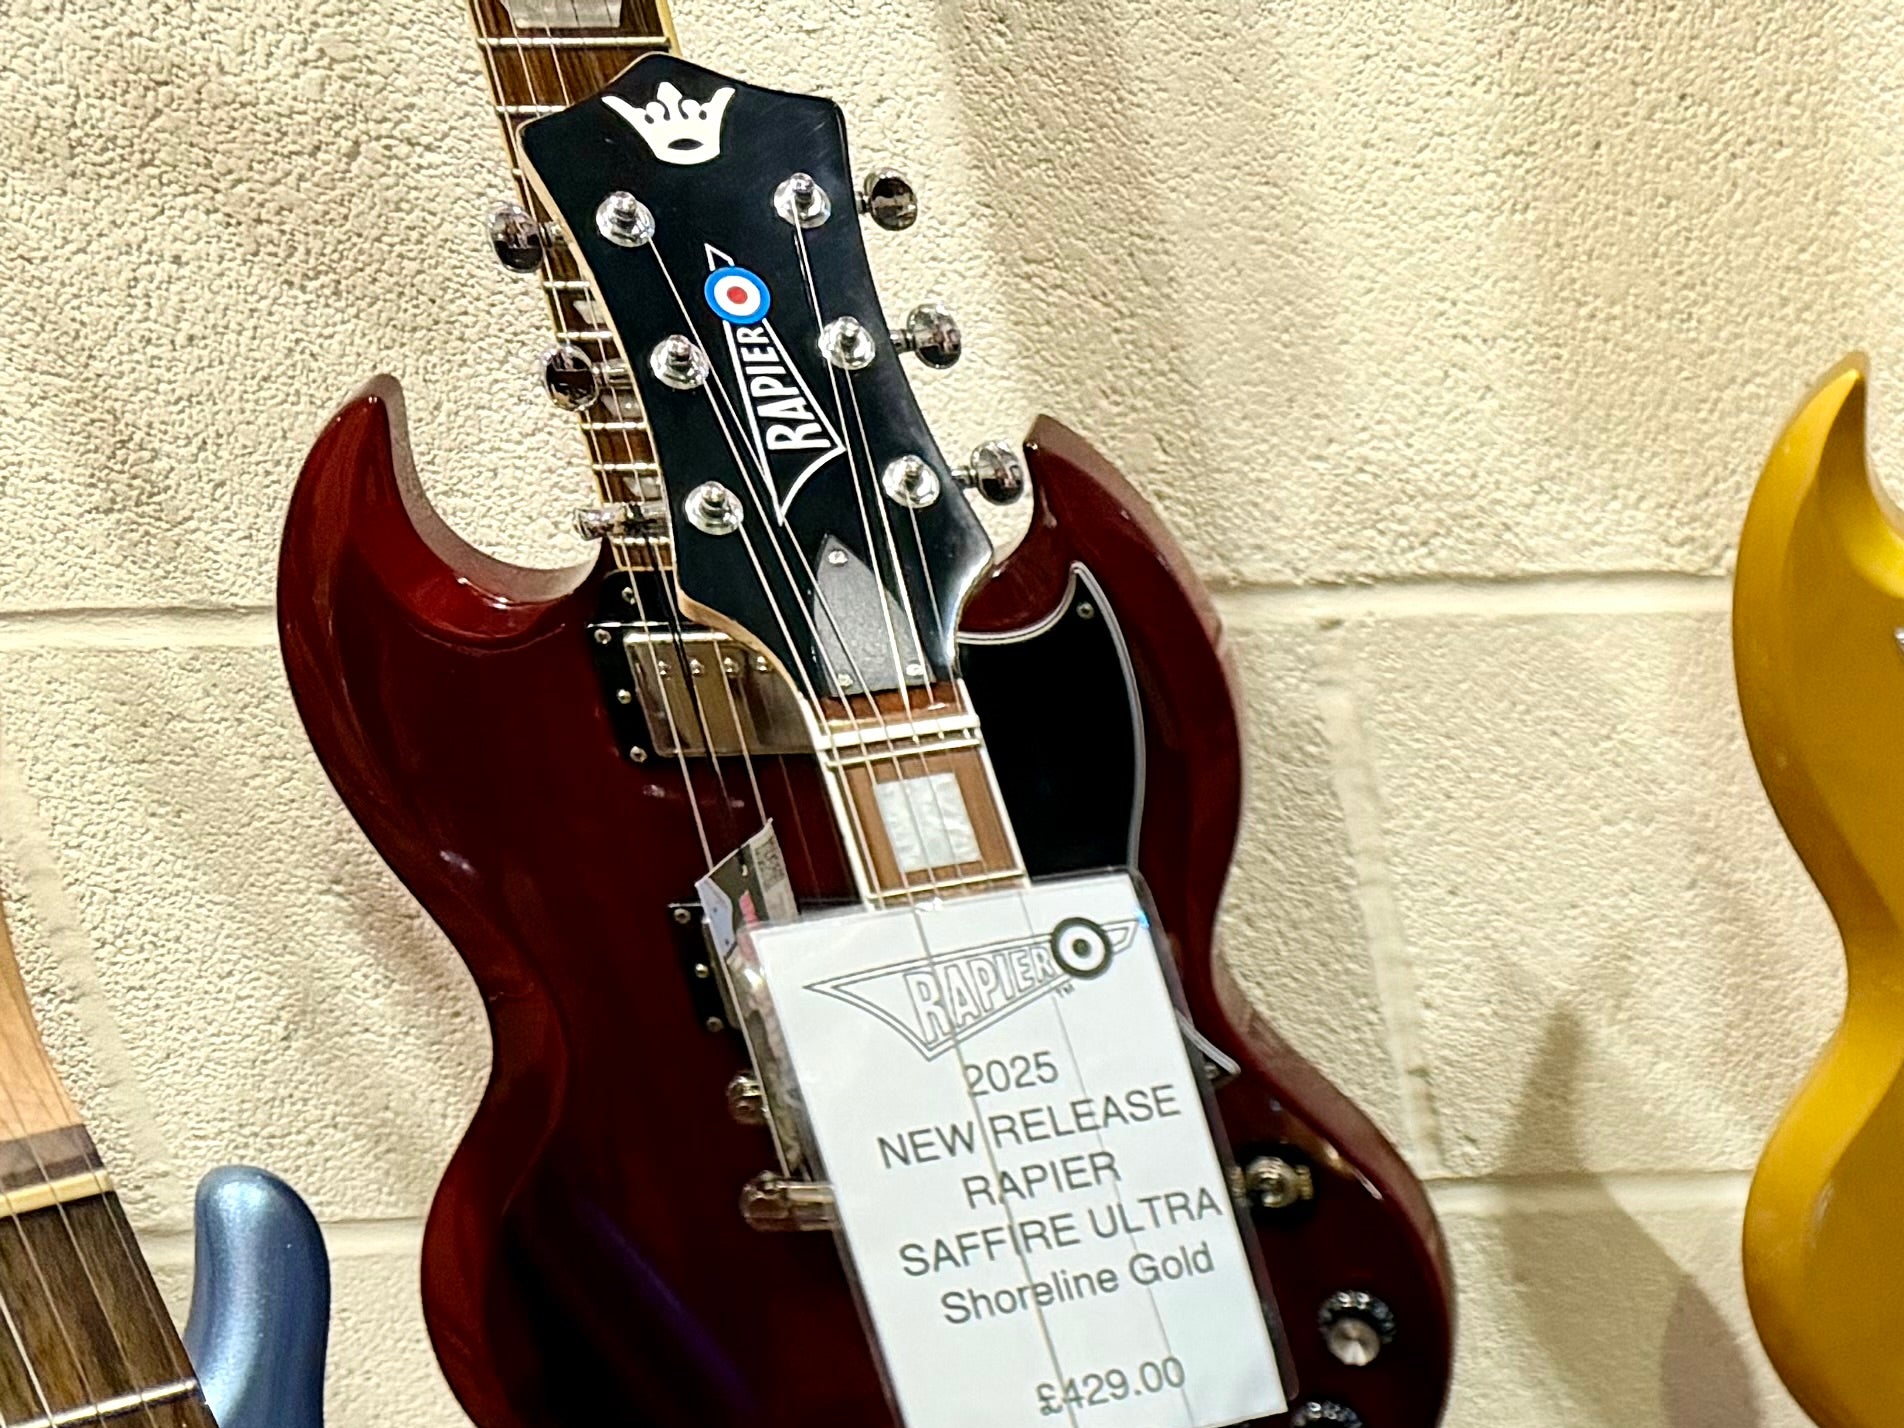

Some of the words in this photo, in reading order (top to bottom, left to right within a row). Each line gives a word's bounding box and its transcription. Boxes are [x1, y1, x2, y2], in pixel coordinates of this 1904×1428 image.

[736, 326, 832, 451] RAPIER
[902, 945, 1061, 1045] RAPIER
[964, 1051, 1058, 1097] 2025
[877, 1121, 975, 1169] NEW
[987, 1084, 1181, 1149] RELEASE
[962, 1151, 1121, 1210] RAPIER
[899, 1212, 1081, 1277] SAFFIRE
[1088, 1187, 1223, 1239] ULTRA
[940, 1267, 1119, 1324] Shoreline
[1129, 1241, 1215, 1286] Gold
[1036, 1356, 1186, 1416] £429.00
